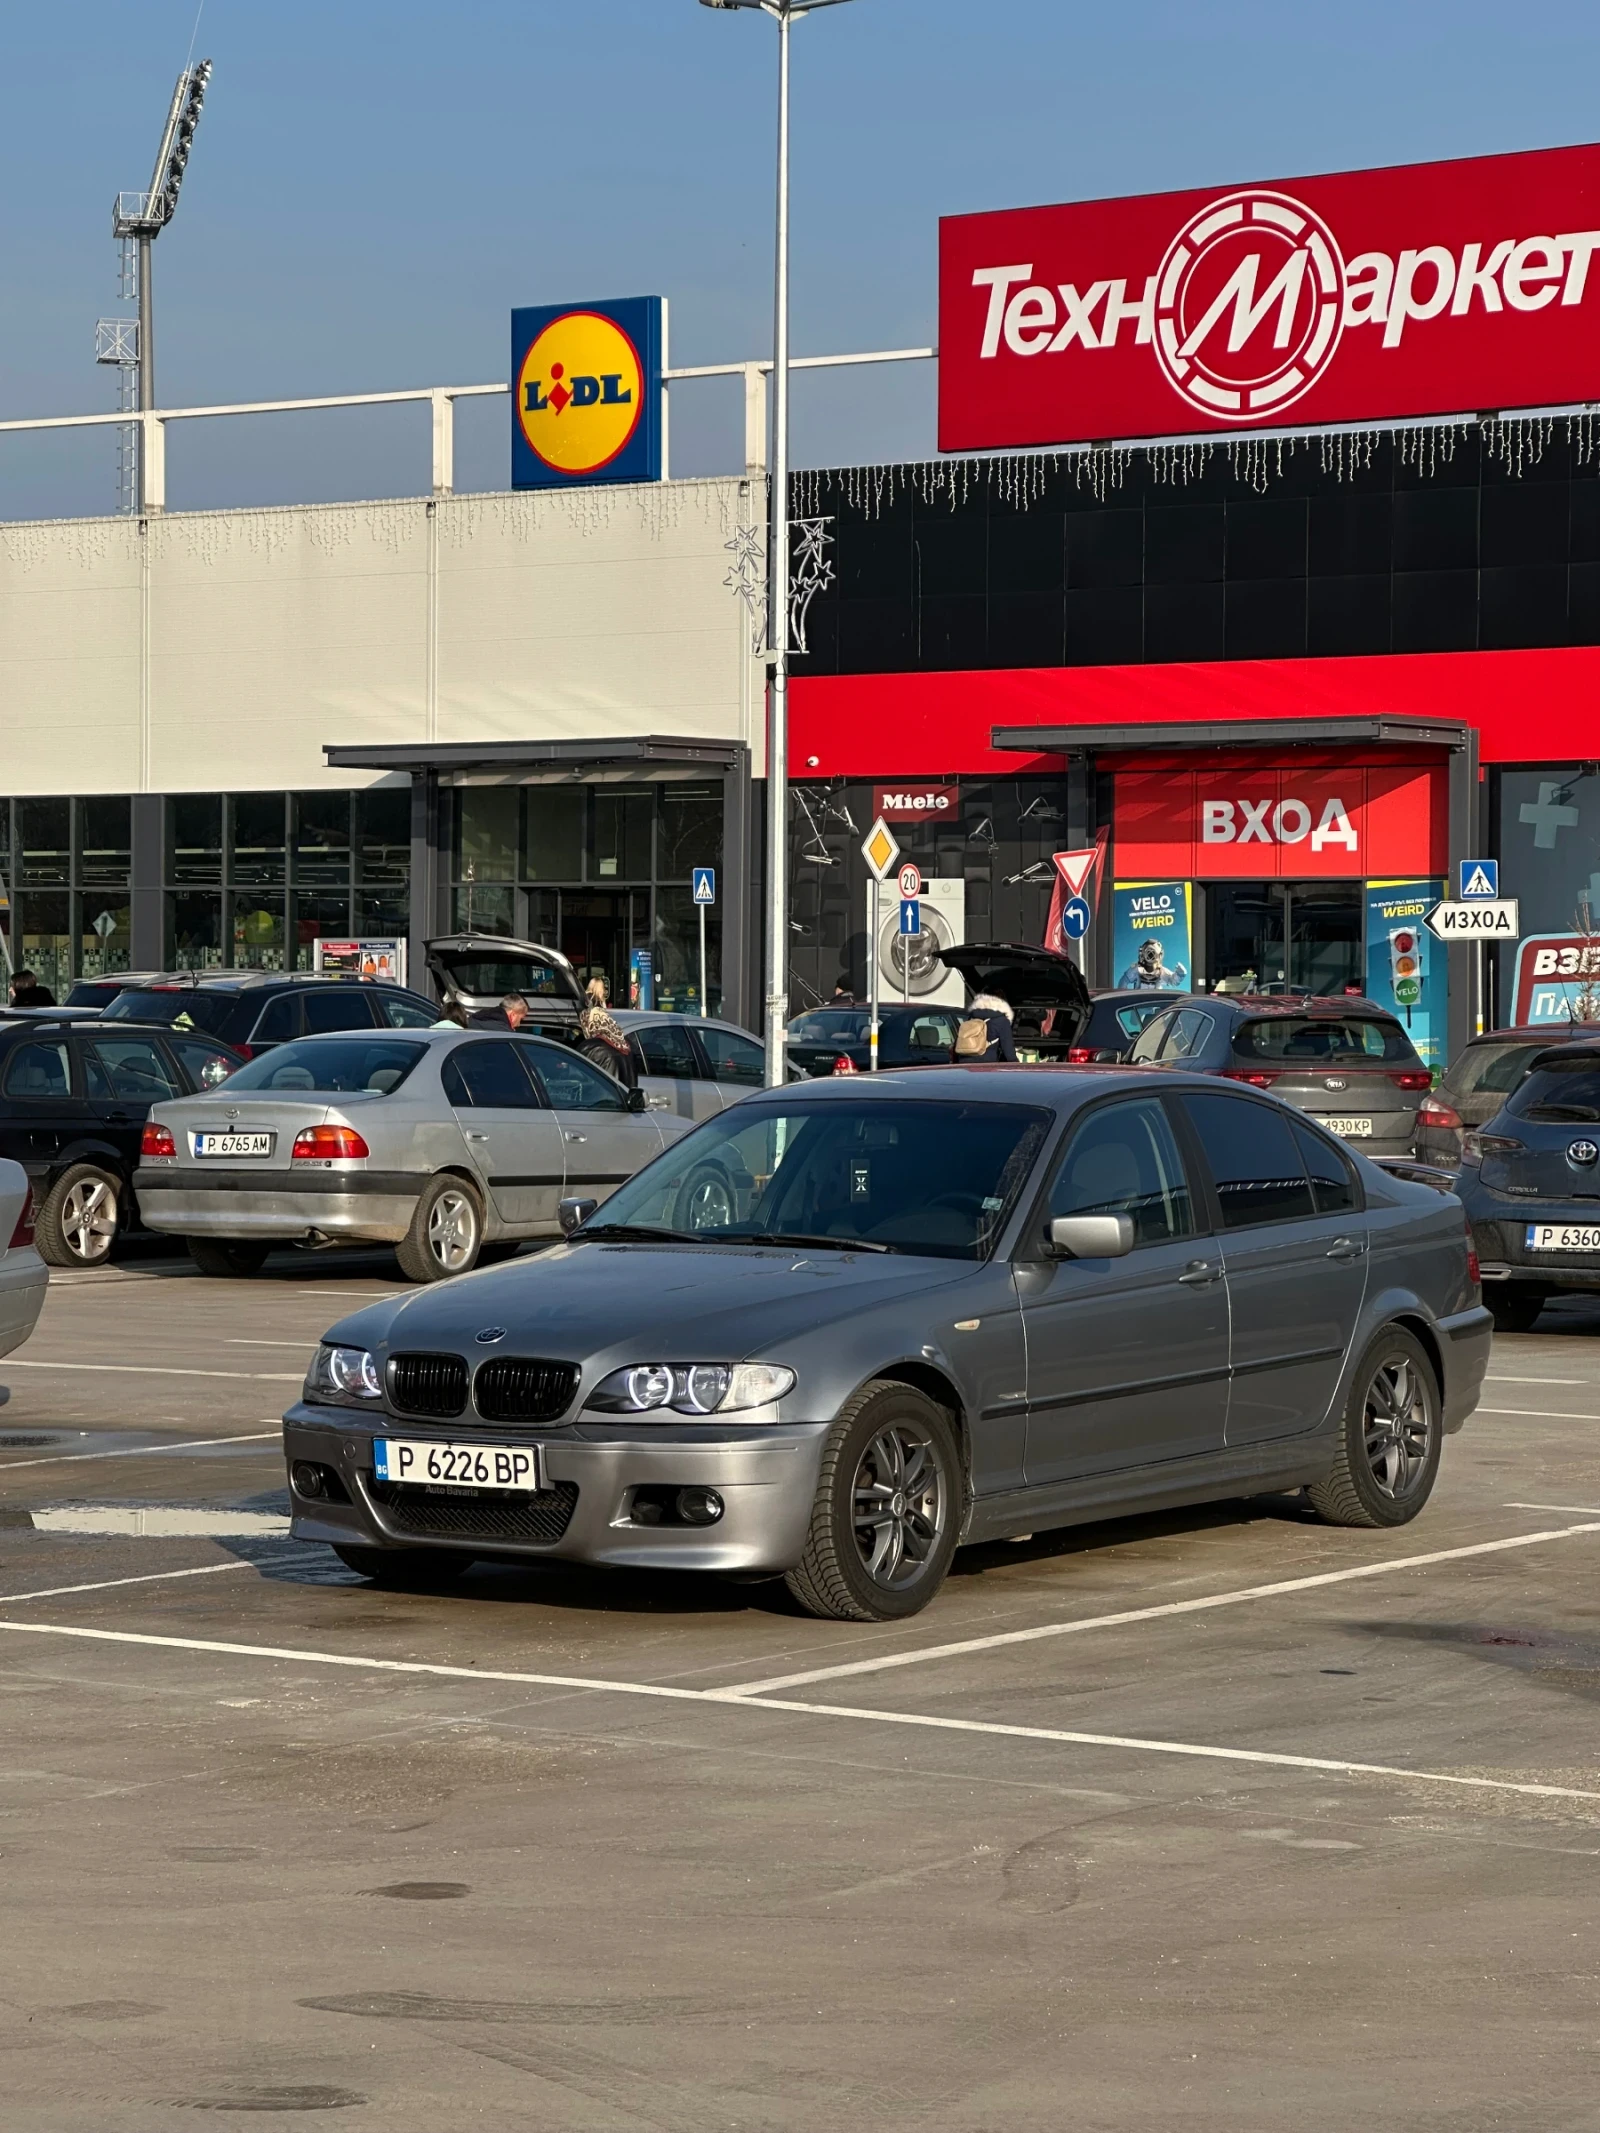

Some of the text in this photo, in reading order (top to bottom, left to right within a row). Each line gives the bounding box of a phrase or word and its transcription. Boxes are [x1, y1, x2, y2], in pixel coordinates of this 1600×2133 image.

[882, 793, 949, 809] Miele
[1202, 799, 1358, 851] ВХОД
[903, 873, 916, 890] 20
[1131, 895, 1171, 911] VELO
[1383, 904, 1425, 918] WEIRD
[1132, 915, 1174, 929] WEIRD
[1444, 911, 1510, 930] ИЗХОД
[1396, 986, 1418, 996] VELO
[1354, 1121, 1370, 1132] KP
[207, 1136, 267, 1151] P 6765 AM
[1542, 1229, 1553, 1246] P
[1561, 1229, 1600, 1247] 6360
[377, 1446, 530, 1484] BG P 6226 BP
[425, 1484, 479, 1497] Auto Bavaria
